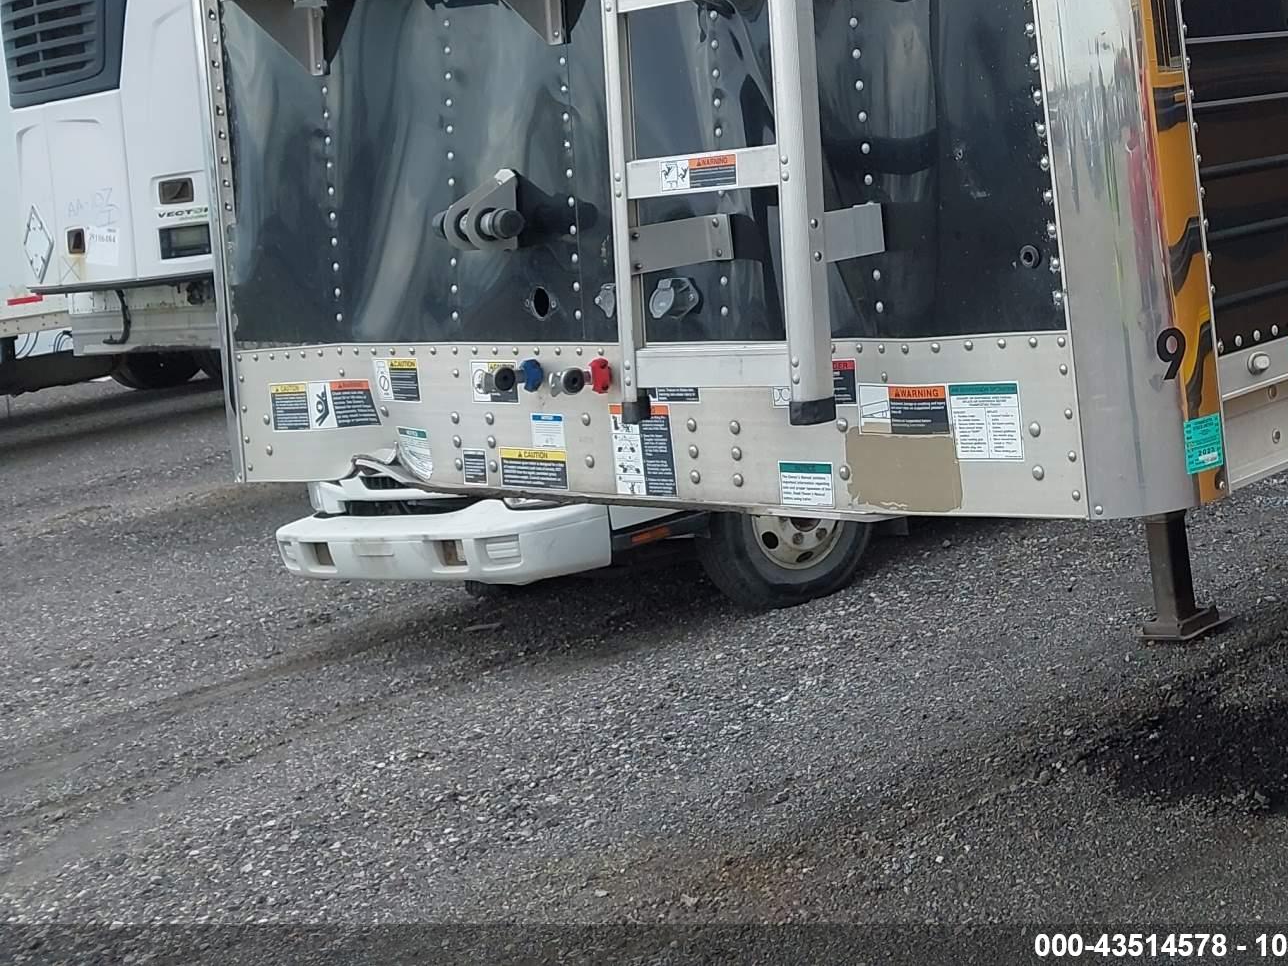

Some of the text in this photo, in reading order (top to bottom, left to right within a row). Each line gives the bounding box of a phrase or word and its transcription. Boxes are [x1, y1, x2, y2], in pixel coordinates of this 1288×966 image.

[1157, 327, 1186, 381] 9
[900, 388, 939, 398] WARNING
[524, 451, 548, 459] CAUTION
